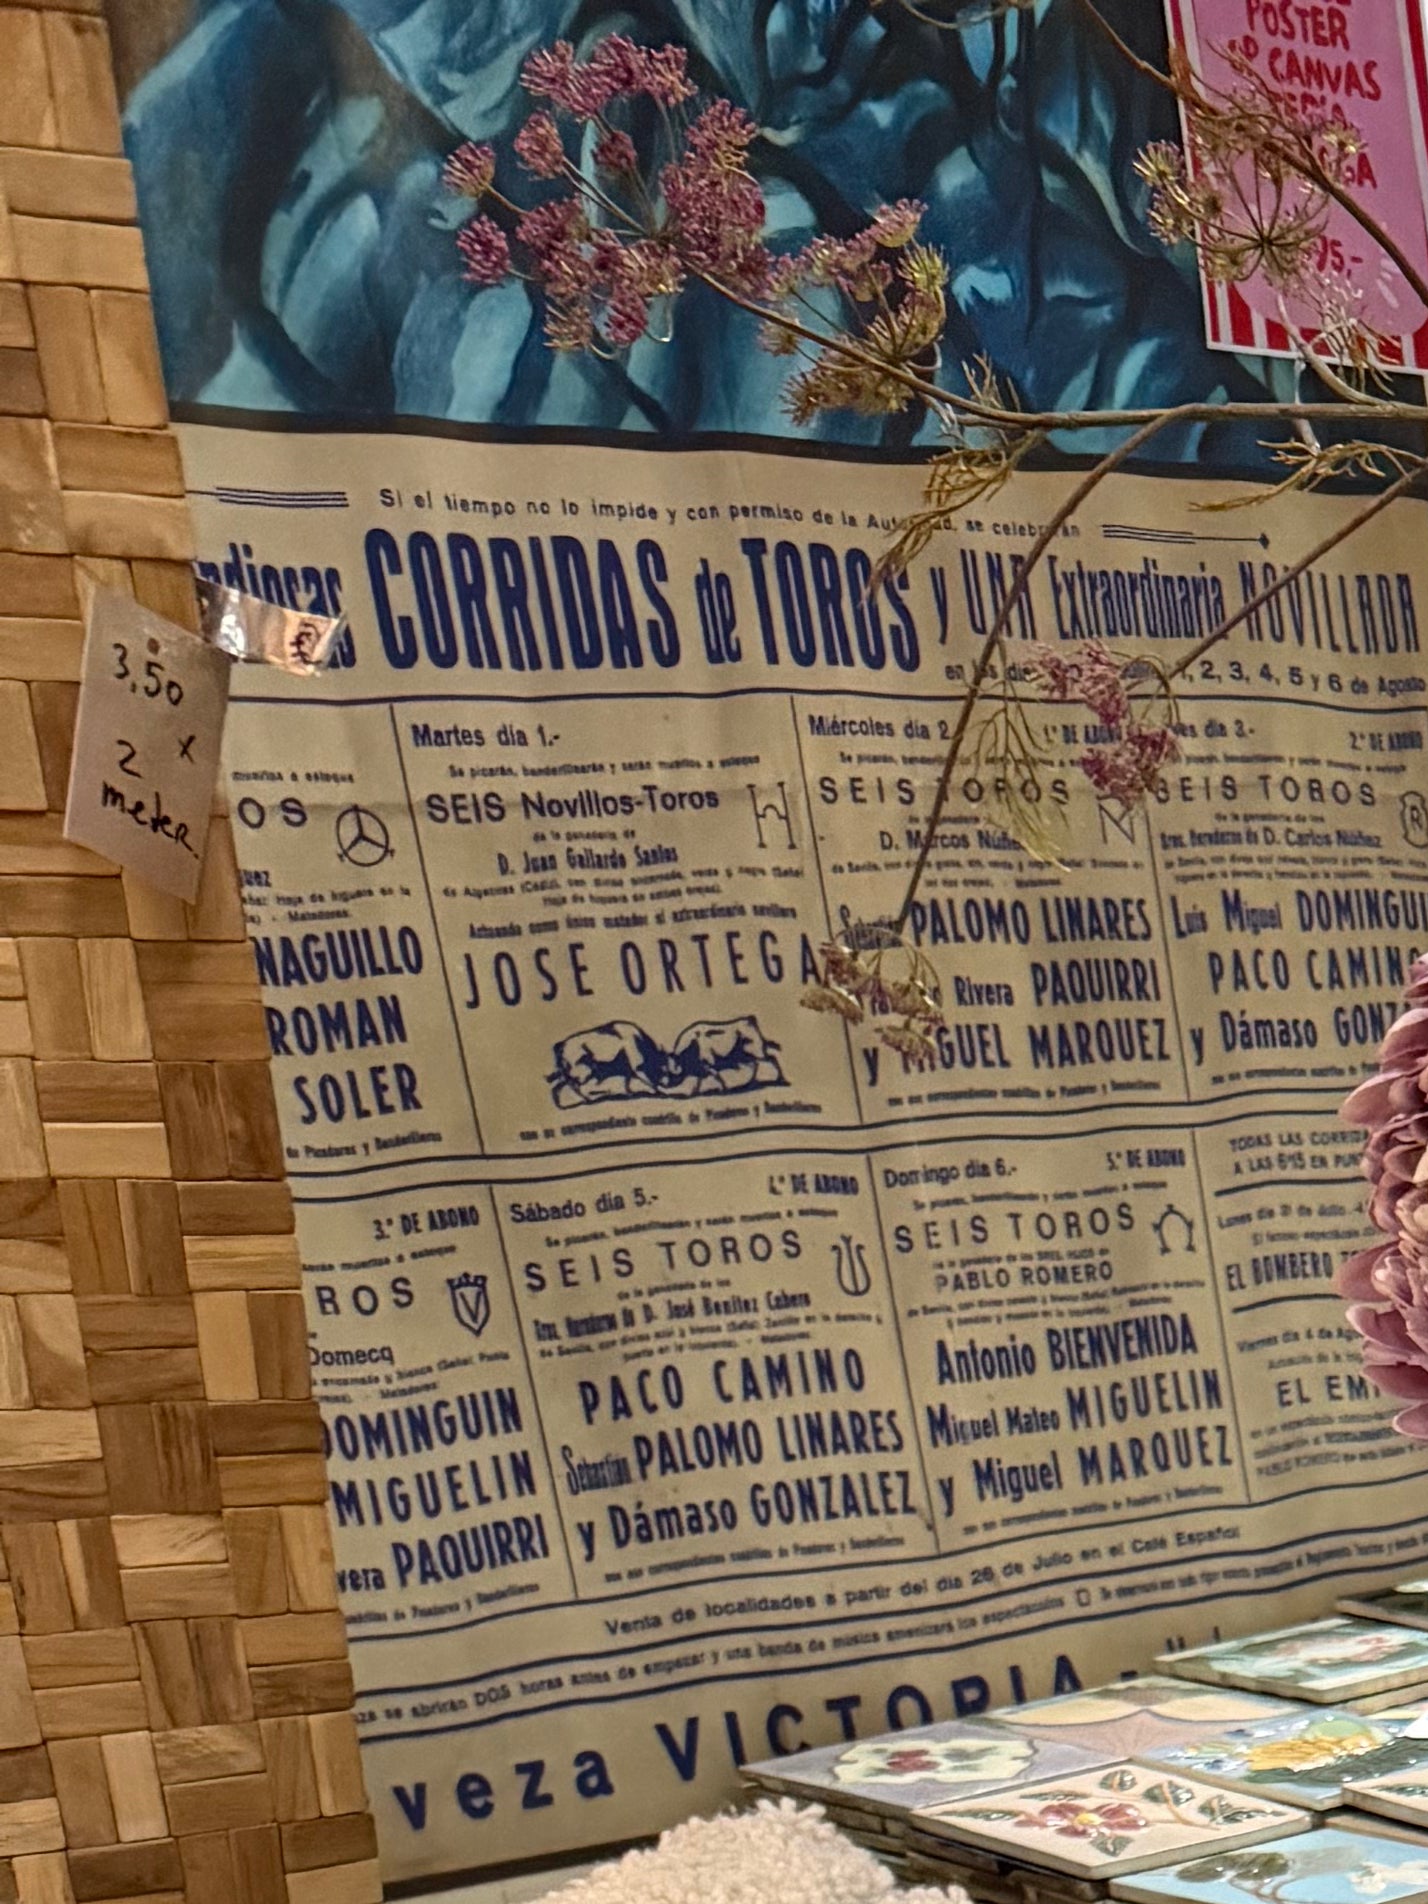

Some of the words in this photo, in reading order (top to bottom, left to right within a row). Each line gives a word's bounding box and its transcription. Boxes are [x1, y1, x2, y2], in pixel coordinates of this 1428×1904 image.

[1268, 47, 1381, 101] CANVAS
[380, 488, 402, 509] Si
[415, 491, 434, 509] el
[446, 493, 516, 517] tiempo
[528, 498, 551, 514] no
[562, 496, 580, 515] lo
[592, 497, 658, 522] impide
[666, 508, 677, 524] y
[686, 504, 720, 521] con
[730, 505, 803, 525] permiso
[813, 508, 834, 525] de
[840, 510, 857, 527] la
[966, 519, 985, 533] se
[364, 527, 682, 671] CORRIDAS
[695, 557, 742, 665] de
[740, 537, 921, 673] TOROS
[930, 565, 948, 645] y
[959, 548, 1037, 641] UNA
[1046, 553, 1229, 642] Extraordinaria
[1238, 560, 1421, 655] NOVILLADA
[1200, 661, 1221, 684] 2,
[1229, 661, 1250, 684] 3,
[1259, 663, 1280, 687] 4,
[1289, 665, 1303, 686] 5
[1328, 673, 1342, 694] 6
[1351, 677, 1368, 695] de
[1378, 676, 1427, 699] Agosto
[411, 724, 485, 748] Martes
[808, 714, 895, 738] Miércoles
[1370, 732, 1384, 751] DE
[1388, 731, 1423, 751] ABONO
[117, 740, 142, 778] 2
[426, 792, 506, 825] SEIS
[523, 784, 720, 820] Novillos-Toros
[820, 776, 915, 806] SEIS
[1155, 775, 1237, 804] SEIS
[1258, 774, 1376, 806] TOROS
[497, 853, 515, 876] D.
[523, 851, 557, 874] Juan
[566, 847, 627, 870] Gallardo
[634, 843, 678, 865] Santos
[880, 831, 899, 852] D.
[1263, 827, 1281, 846] D.
[1285, 827, 1332, 849] Carlos
[910, 898, 1030, 947] PALOMO
[1040, 897, 1152, 943] LINARES
[1170, 895, 1208, 939] Luis
[1220, 889, 1282, 935] Miguel
[464, 942, 594, 1010] JOSE
[619, 929, 821, 995] ORTEGA
[954, 975, 1014, 1007] Rivera
[1030, 958, 1161, 1006] PAQUIRRI
[1208, 948, 1290, 995] PACO
[264, 993, 408, 1056] ROMAN
[1190, 1026, 1204, 1066] y
[1219, 1009, 1317, 1051] Dámaso
[863, 1047, 878, 1086] y
[1028, 1018, 1170, 1069] MARQUEZ
[293, 1062, 423, 1125] SOLER
[883, 1163, 960, 1189] Domingo
[1127, 1149, 1142, 1168] DE
[791, 1174, 808, 1195] DE
[814, 1173, 859, 1195] ABONO
[400, 1212, 422, 1236] DE
[428, 1205, 480, 1232] ABONO
[510, 1201, 586, 1224] Sábado
[894, 1213, 989, 1254] SEIS
[1007, 1201, 1134, 1241] TOROS
[524, 1248, 635, 1293] SEIS
[657, 1229, 802, 1271] TOROS
[934, 1267, 1010, 1294] PABLO
[1020, 1260, 1113, 1288] ROMERO
[1225, 1263, 1246, 1292] EL
[1251, 1251, 1334, 1286] BOMBERO
[667, 1296, 695, 1320] José
[936, 1333, 1037, 1386] Antonio
[1046, 1313, 1198, 1372] BIENVENIDA
[578, 1363, 684, 1426] PACO
[713, 1347, 865, 1403] CAMINO
[926, 1403, 1000, 1448] Miguel
[1005, 1404, 1061, 1435] Mateo
[1065, 1368, 1223, 1432] MIGUELIN
[1276, 1375, 1311, 1409] EL
[633, 1419, 763, 1481] PALOMO
[776, 1409, 904, 1463] LINARES
[330, 1450, 536, 1527] MIGUELIN
[938, 1475, 954, 1517] y
[972, 1449, 1063, 1502] Miguel
[1078, 1424, 1232, 1488] MARQUEZ
[577, 1519, 595, 1563] y
[608, 1496, 738, 1551] Dámaso
[750, 1470, 917, 1528] GONZALEZ
[391, 1513, 550, 1588] PAQUIRRI
[605, 1613, 662, 1637] Venta
[671, 1606, 697, 1625] de
[705, 1595, 816, 1619] localidades
[826, 1595, 837, 1607] a
[844, 1584, 892, 1606] partir
[900, 1577, 927, 1597] del
[1001, 1560, 1024, 1578] de
[1031, 1551, 1074, 1571] Julio
[1080, 1546, 1101, 1561] en
[1108, 1540, 1125, 1558] el
[1175, 1526, 1240, 1548] Español
[473, 1685, 512, 1708] DOS
[520, 1675, 563, 1696] horas
[618, 1664, 636, 1681] de
[808, 1637, 827, 1653] de
[655, 1652, 1083, 1784] VICTORIA
